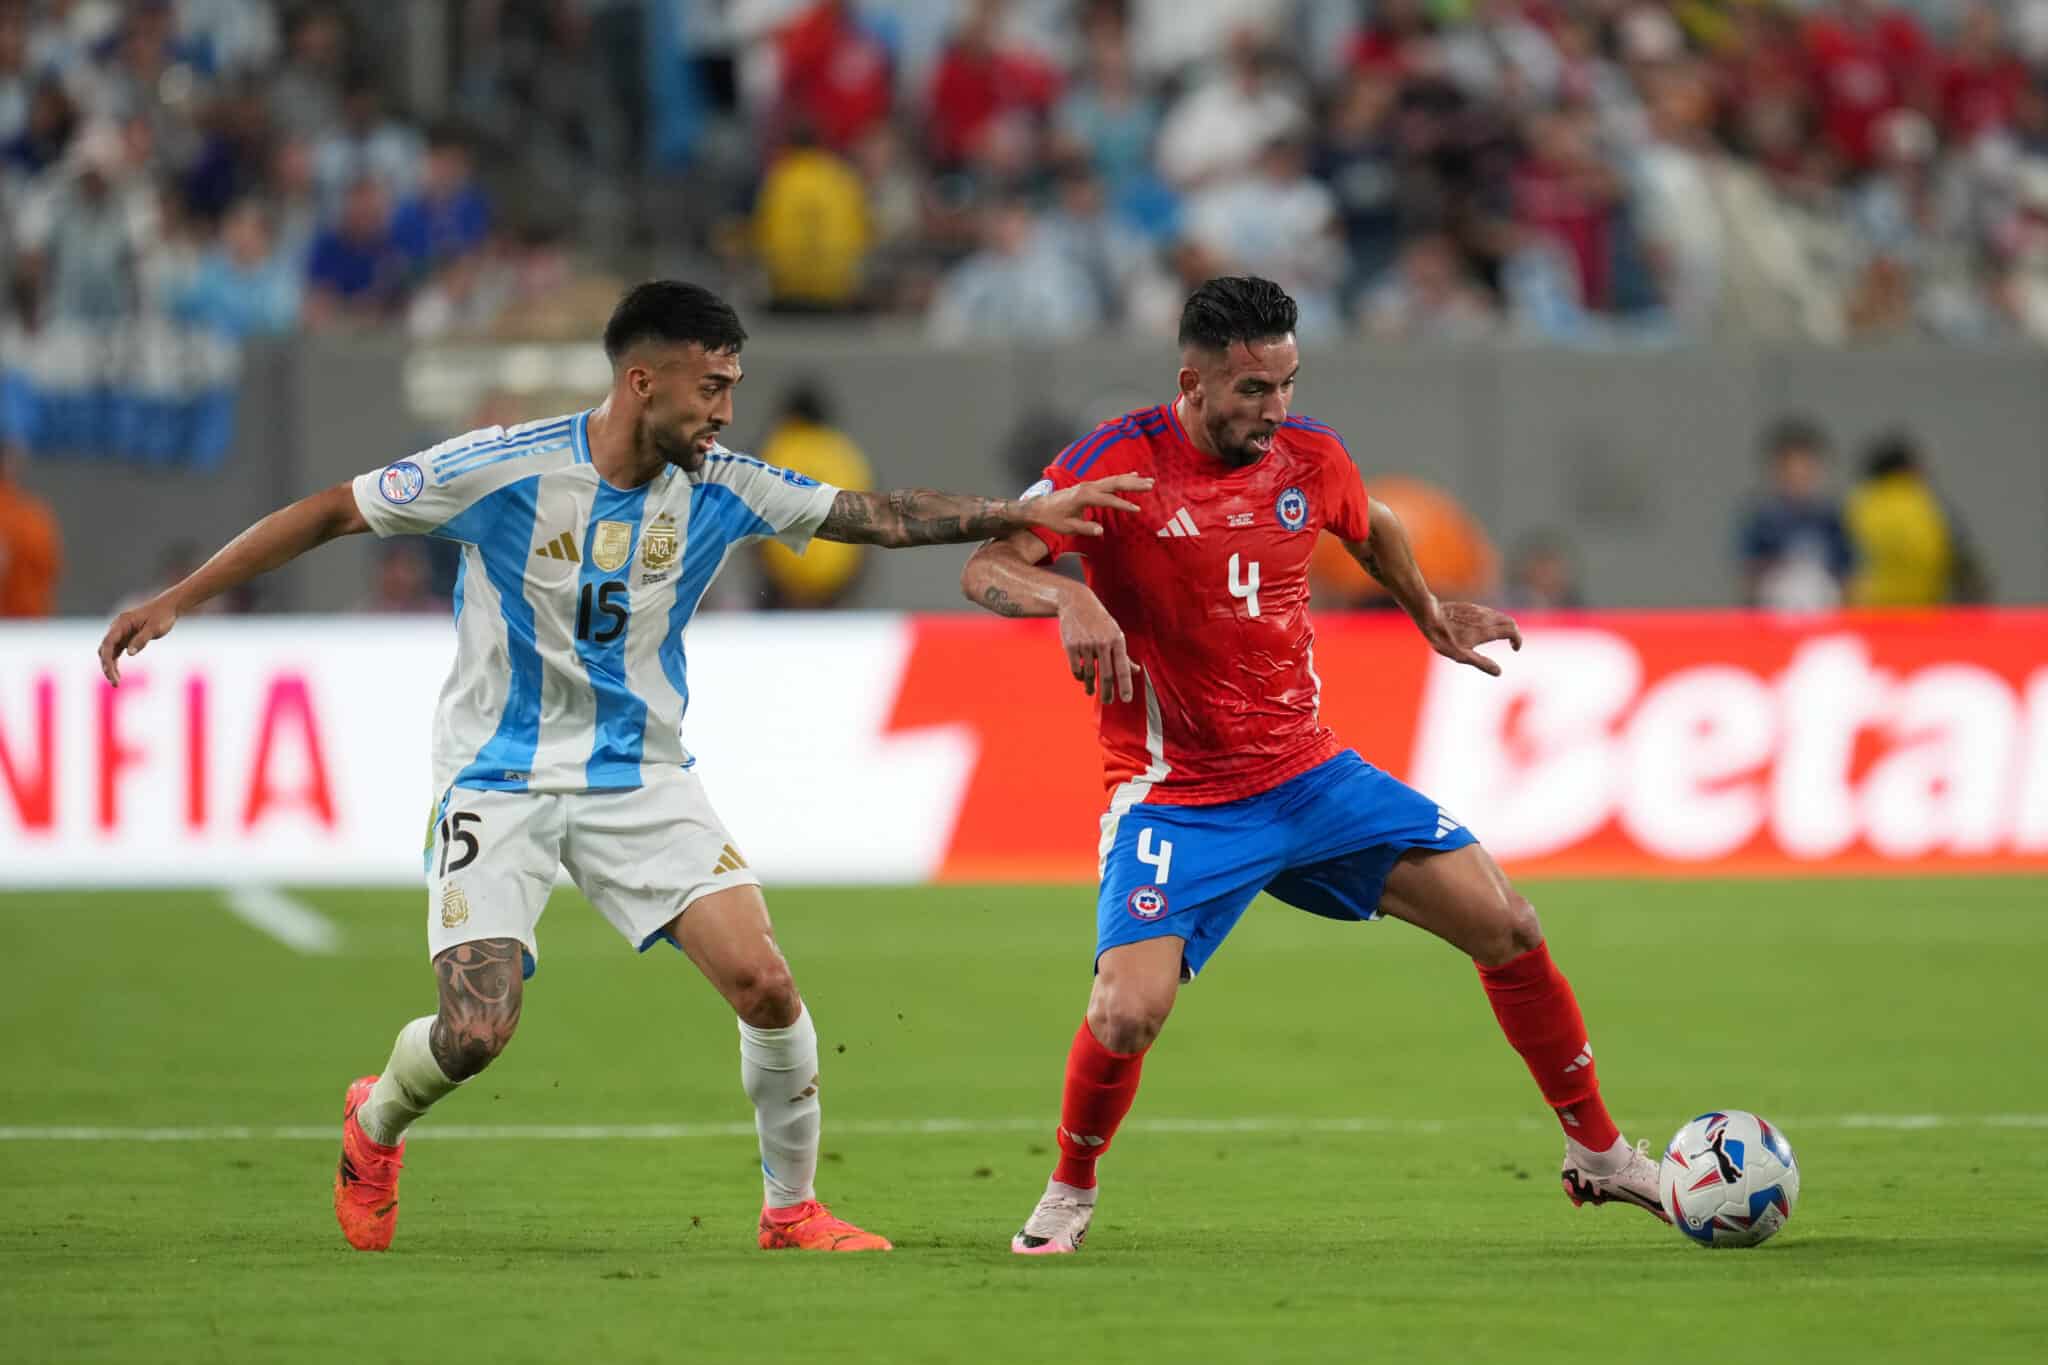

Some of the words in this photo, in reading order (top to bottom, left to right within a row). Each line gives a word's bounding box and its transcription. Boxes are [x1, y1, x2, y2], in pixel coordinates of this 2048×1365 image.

[577, 581, 631, 641] 15
[1228, 552, 1261, 617] 4
[440, 811, 482, 878] 15
[1137, 827, 1173, 885] 4
